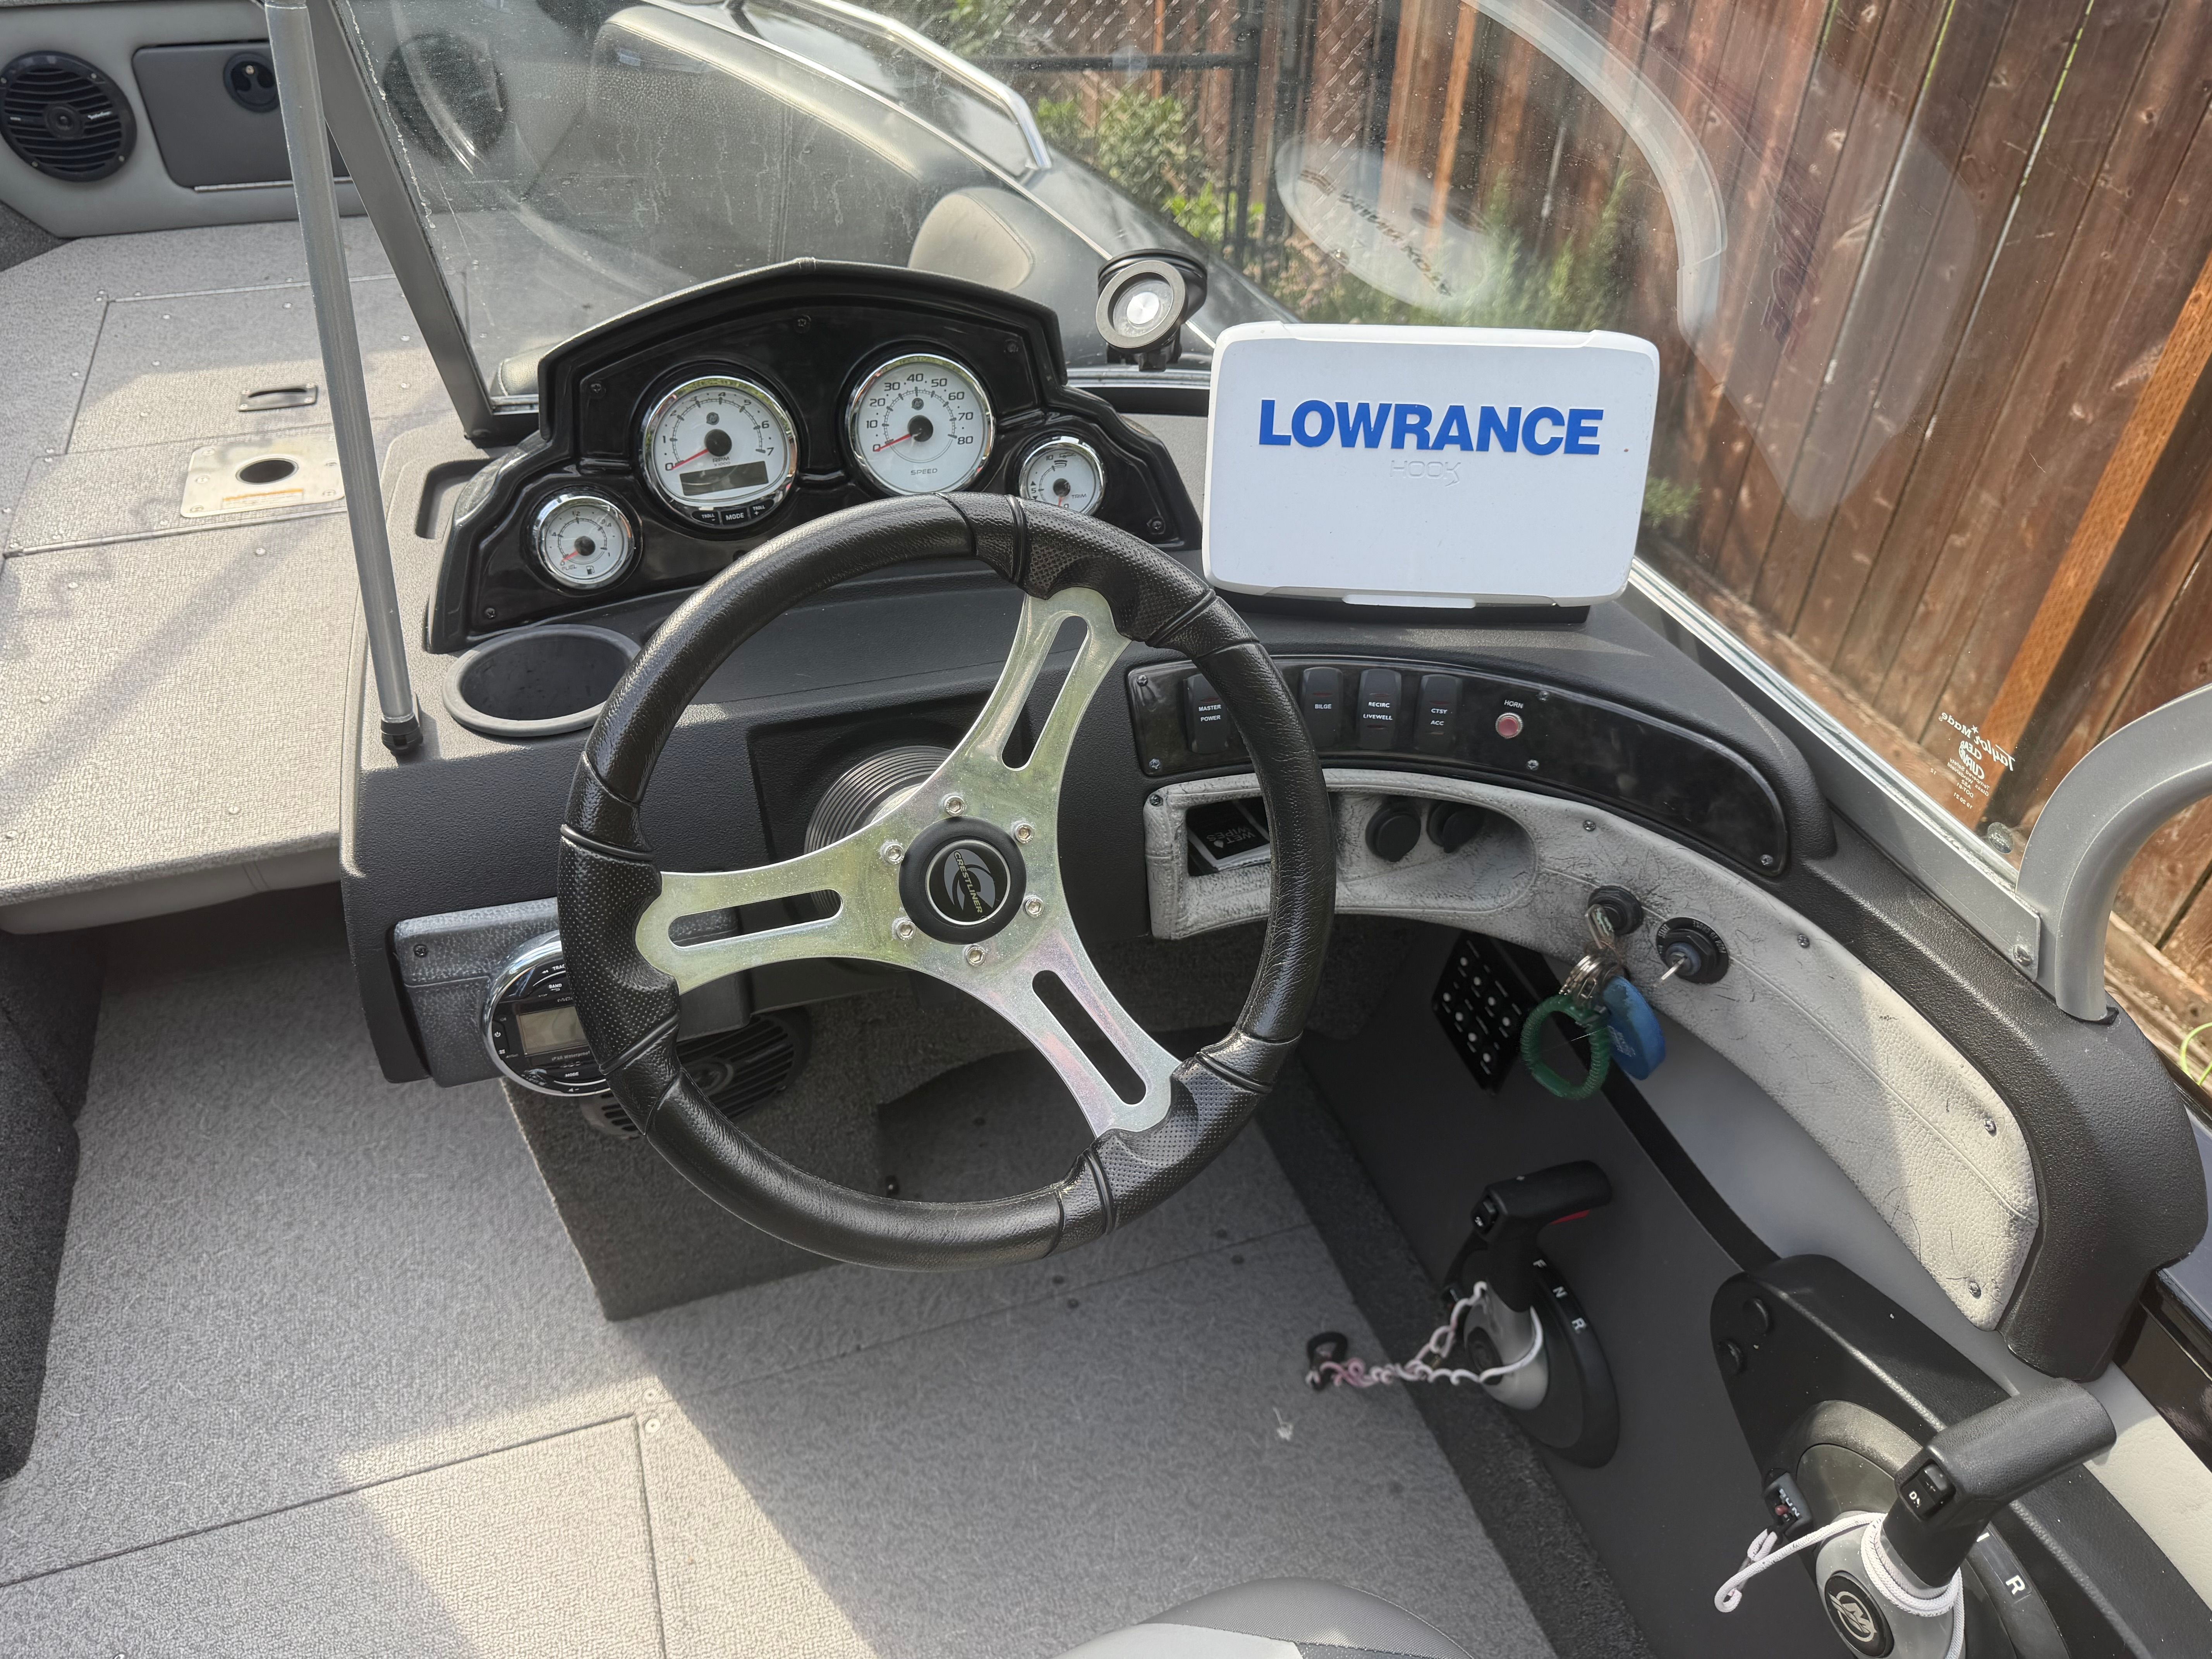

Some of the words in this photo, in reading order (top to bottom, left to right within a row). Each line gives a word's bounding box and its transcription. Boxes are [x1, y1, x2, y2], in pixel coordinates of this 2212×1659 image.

[907, 374, 924, 382] 40
[884, 382, 900, 391] 30
[931, 379, 947, 387] 50
[948, 392, 964, 400] 60
[870, 398, 885, 407] 20
[958, 412, 973, 421] 70
[866, 420, 878, 428] 10
[1259, 399, 1604, 456] LOWRANCE
[957, 436, 973, 445] 80
[767, 447, 774, 455] 7
[872, 444, 881, 452] 0
[1389, 460, 1461, 487] HOOK
[1504, 700, 1524, 709] HORN
[1206, 826, 1250, 842] WIPES
[1226, 831, 1256, 843] WET
[954, 852, 983, 913] CRESTLINER
[563, 1050, 590, 1060] Waterproof
[1533, 1259, 1547, 1268] F
[1553, 1286, 1568, 1299] N
[1571, 1318, 1587, 1333] R
[2005, 1574, 2026, 1595] R
